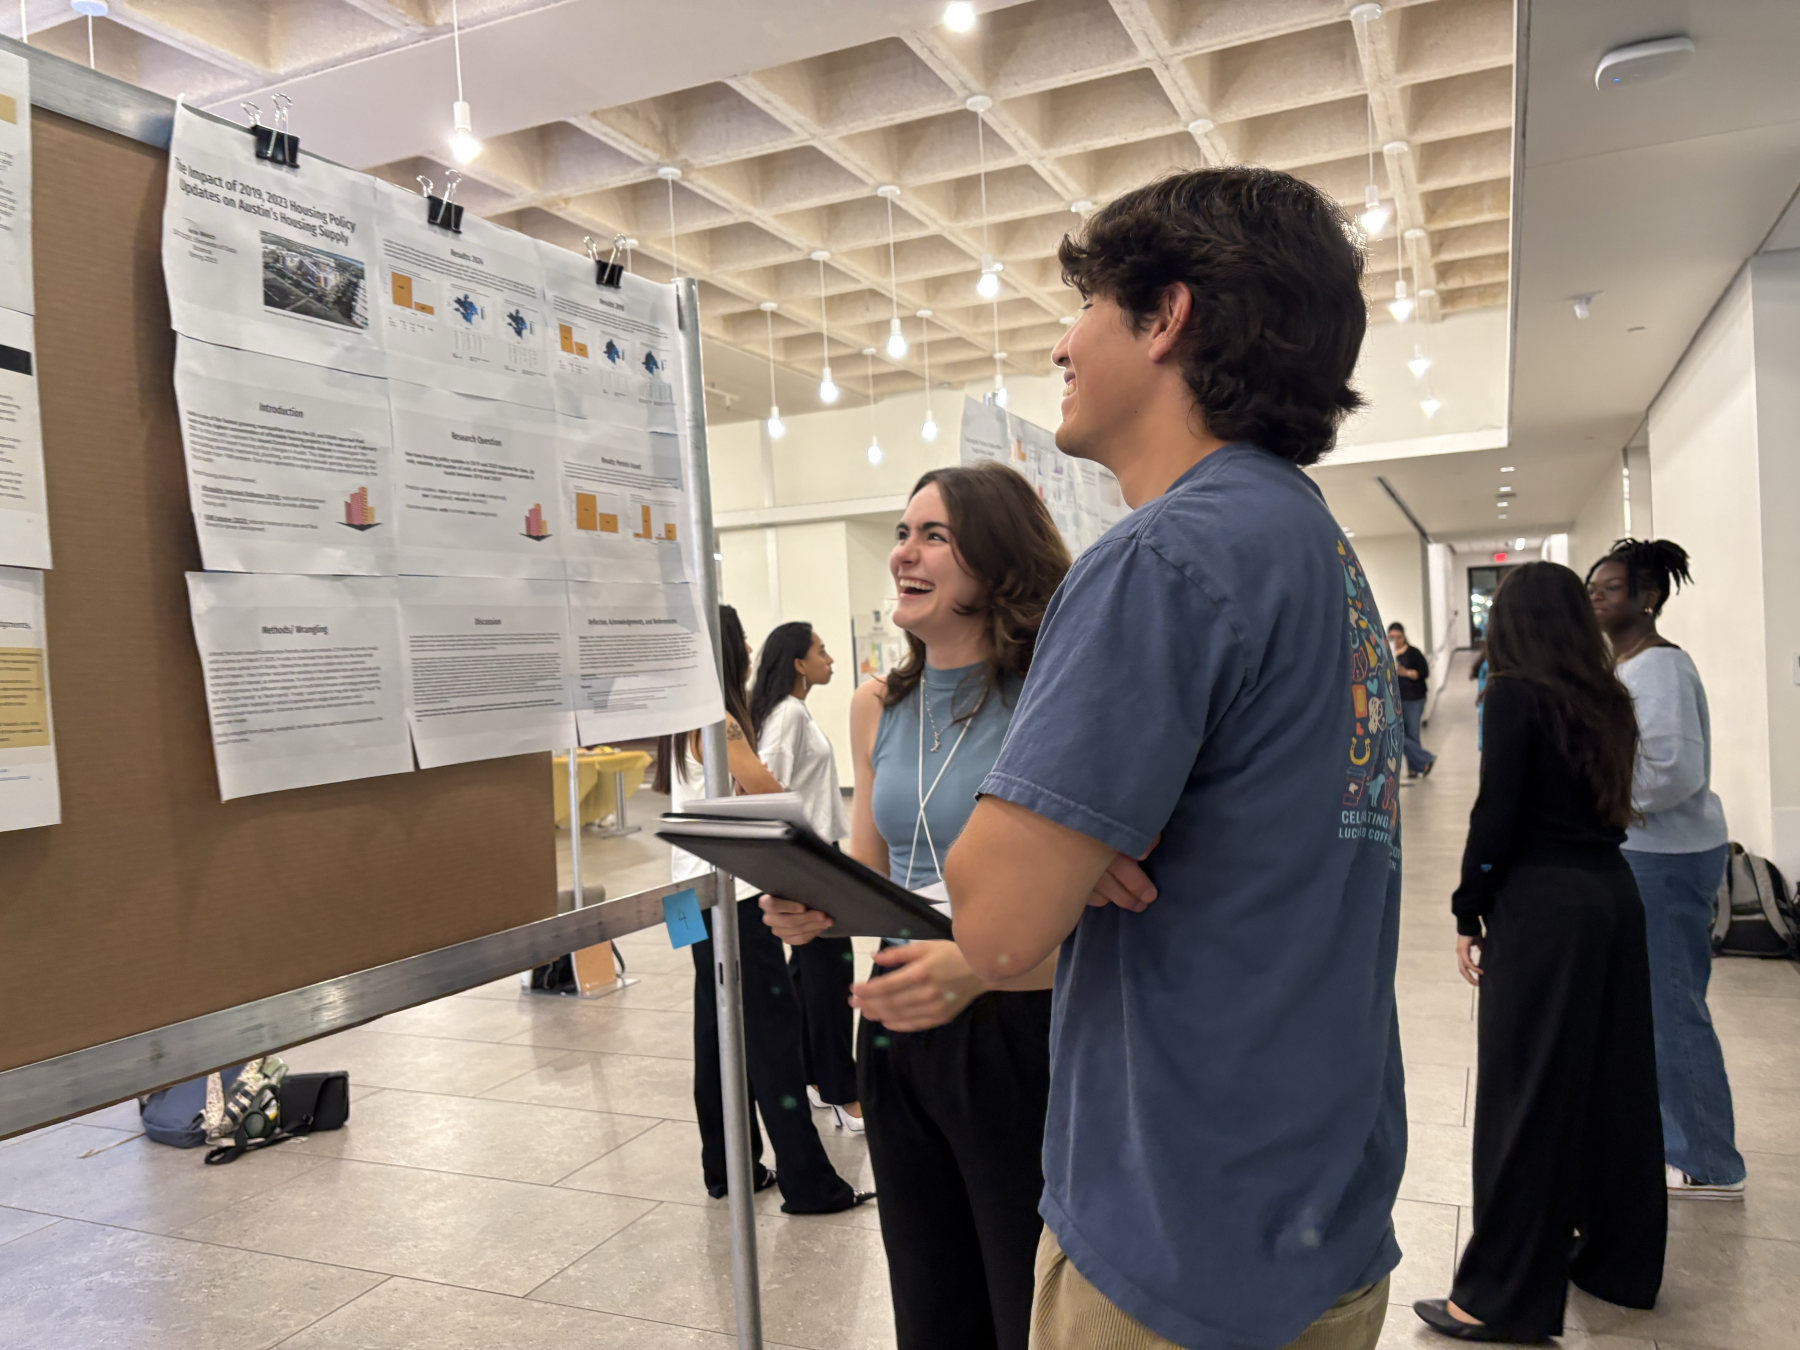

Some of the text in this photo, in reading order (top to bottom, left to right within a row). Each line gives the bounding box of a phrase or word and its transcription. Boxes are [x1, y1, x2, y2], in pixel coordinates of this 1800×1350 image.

[188, 165, 225, 189] Impact
[225, 179, 239, 193] of
[239, 183, 265, 202] 2019,
[266, 191, 288, 209] 2023
[290, 199, 328, 225] Housing
[329, 212, 356, 233] Policy
[179, 177, 349, 247] Updates on Austin's Housing Supply
[258, 402, 304, 418] Introduction
[451, 431, 502, 447] Research Question
[678, 909, 689, 930] 4
